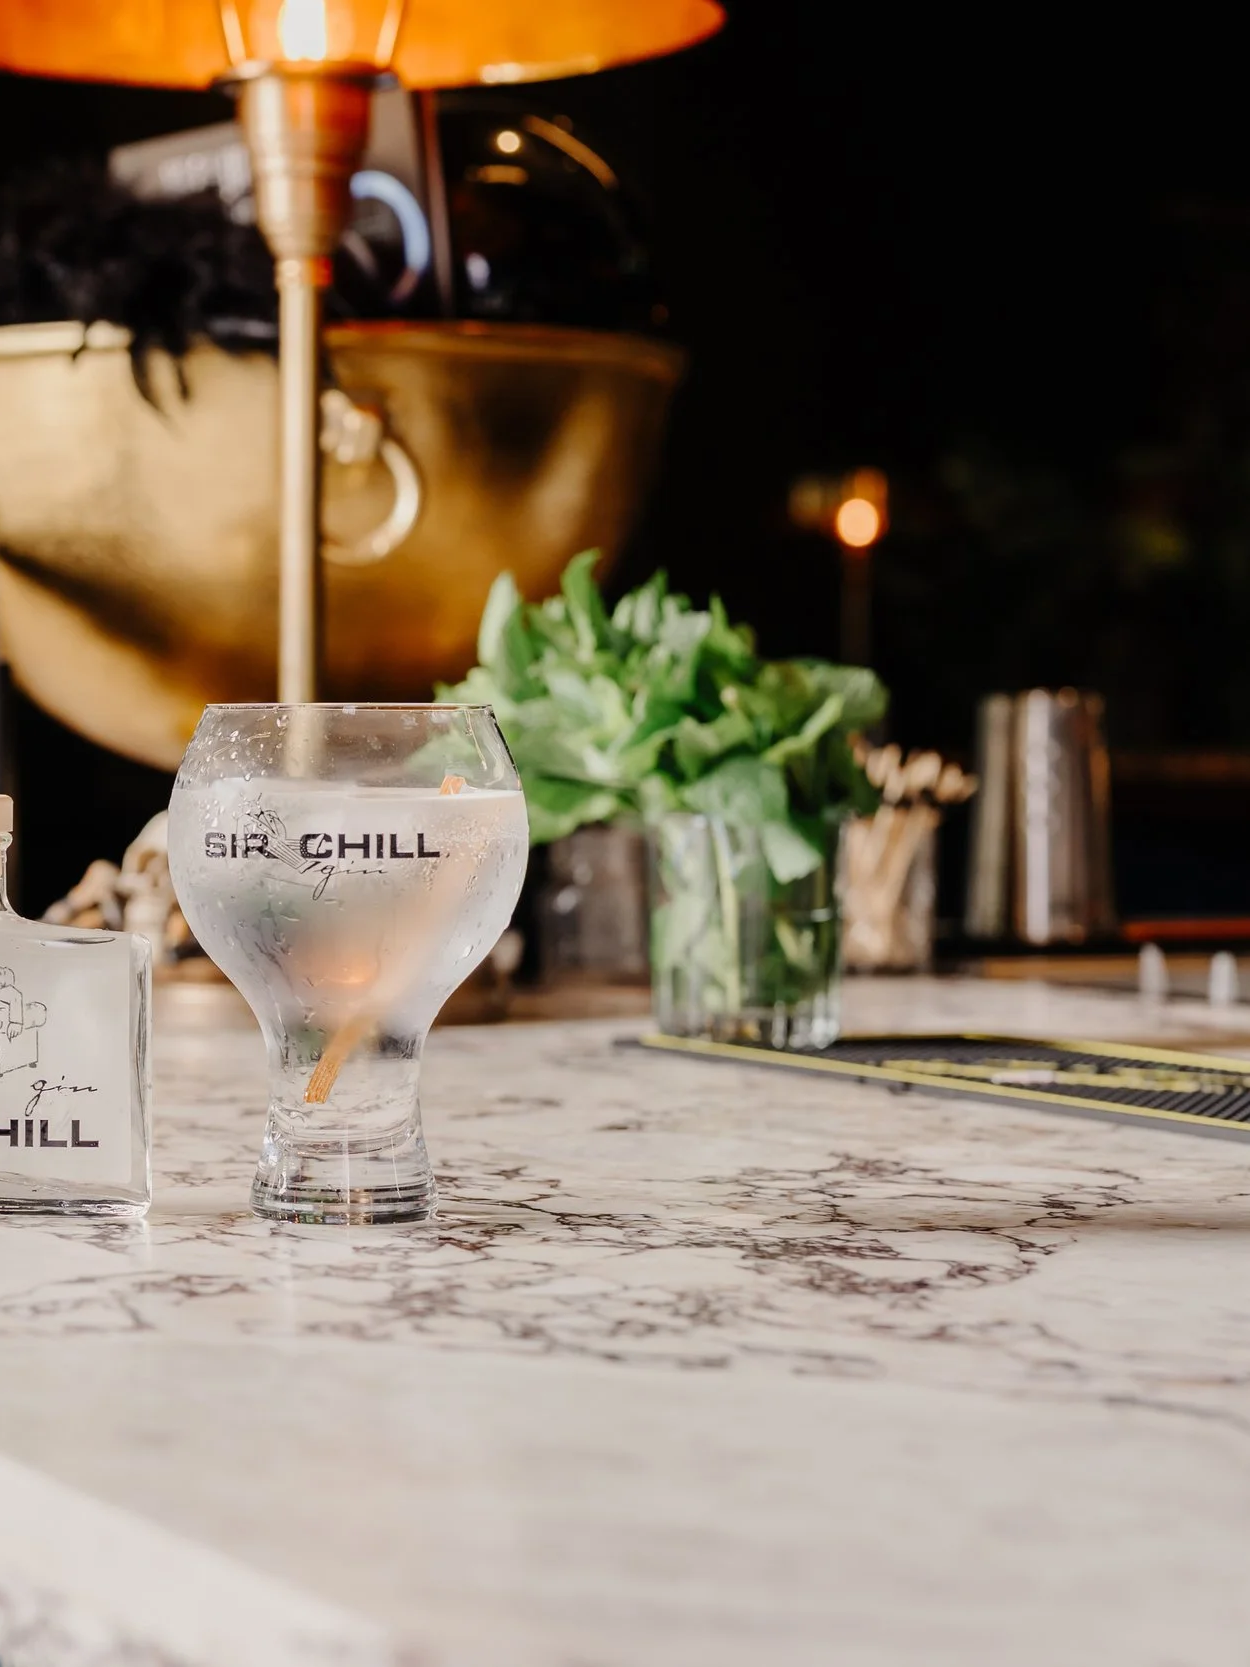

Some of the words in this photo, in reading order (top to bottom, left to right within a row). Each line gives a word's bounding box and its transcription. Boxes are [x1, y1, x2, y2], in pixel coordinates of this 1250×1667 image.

[205, 832, 280, 859] SIR
[300, 833, 440, 858] CHILL
[25, 1076, 98, 1117] gin
